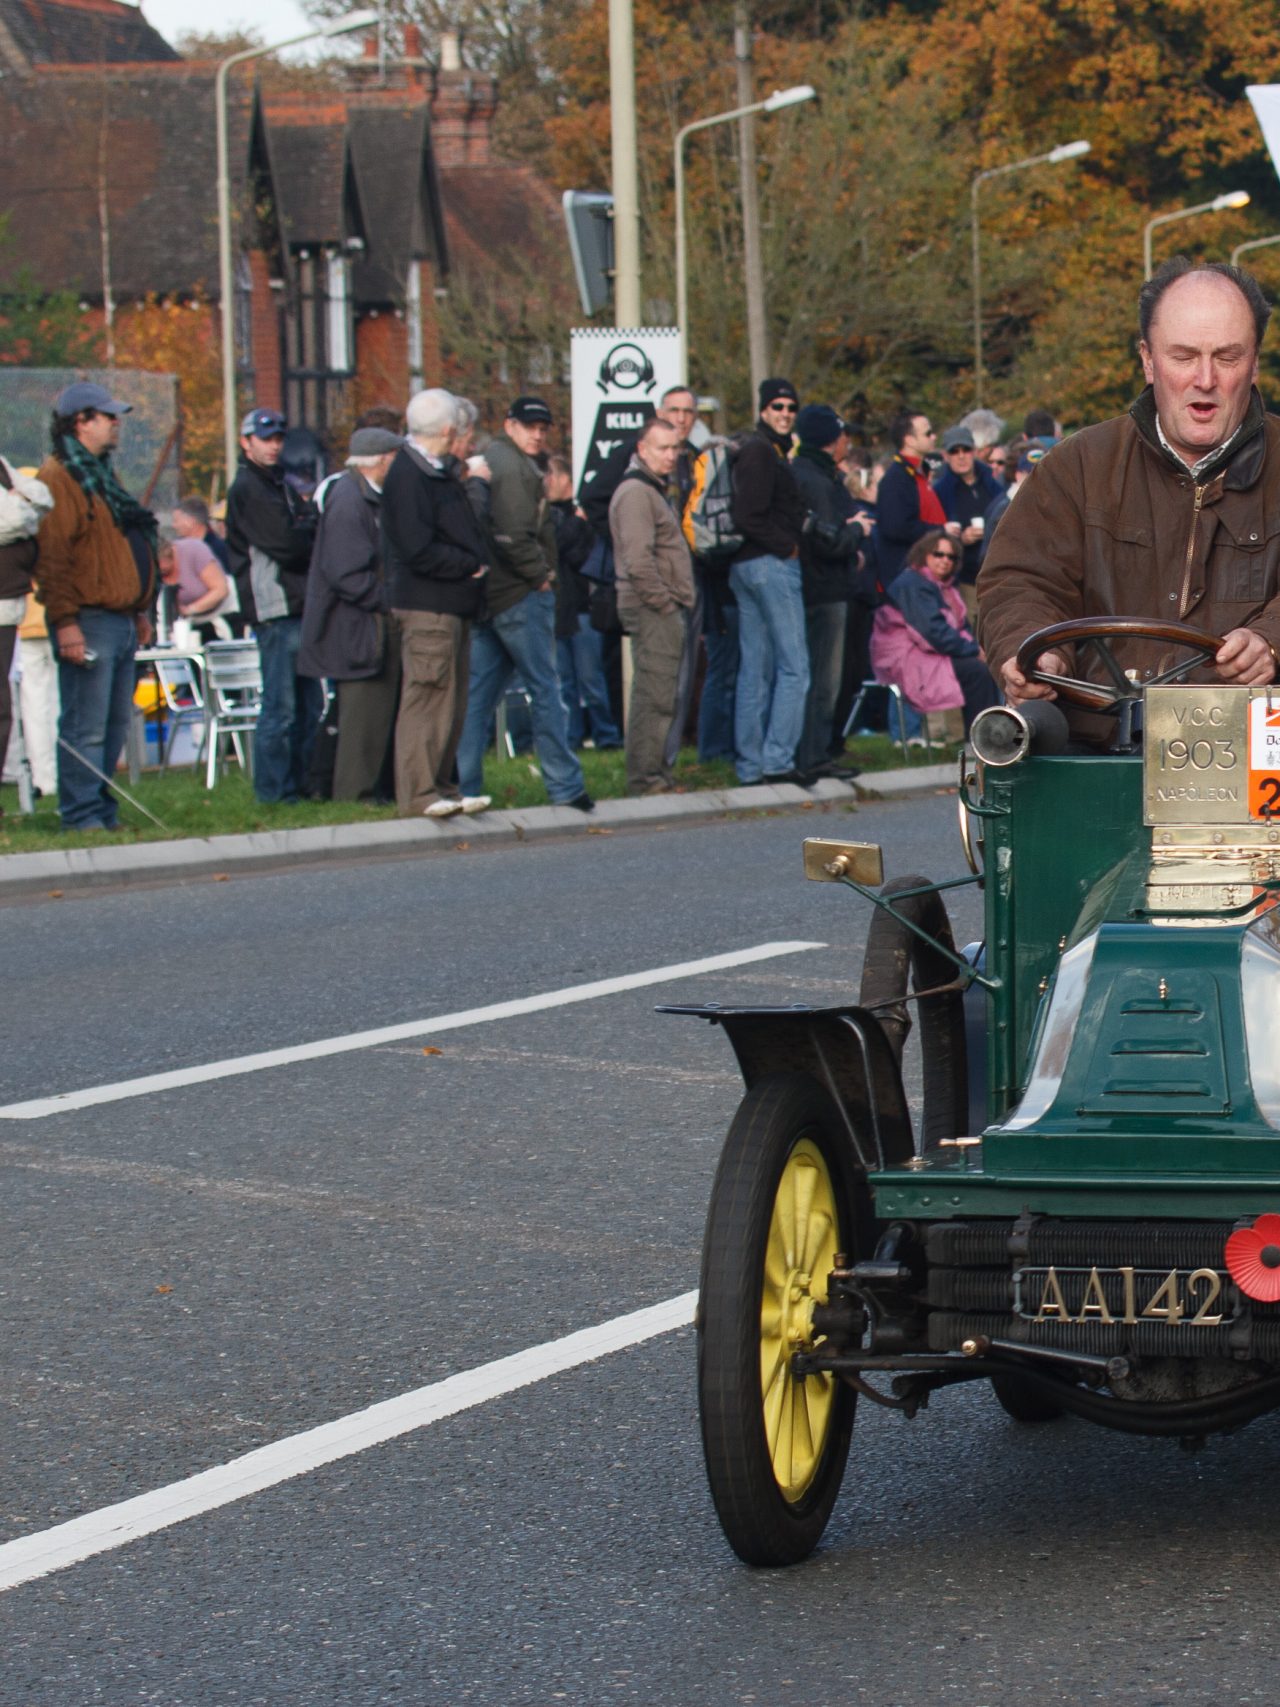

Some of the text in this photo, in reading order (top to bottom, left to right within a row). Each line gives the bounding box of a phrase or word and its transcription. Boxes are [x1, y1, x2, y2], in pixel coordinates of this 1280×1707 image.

[1159, 739, 1237, 771] 1903
[1156, 787, 1239, 802] NAPOLEON
[1033, 1266, 1224, 1326] AA142
